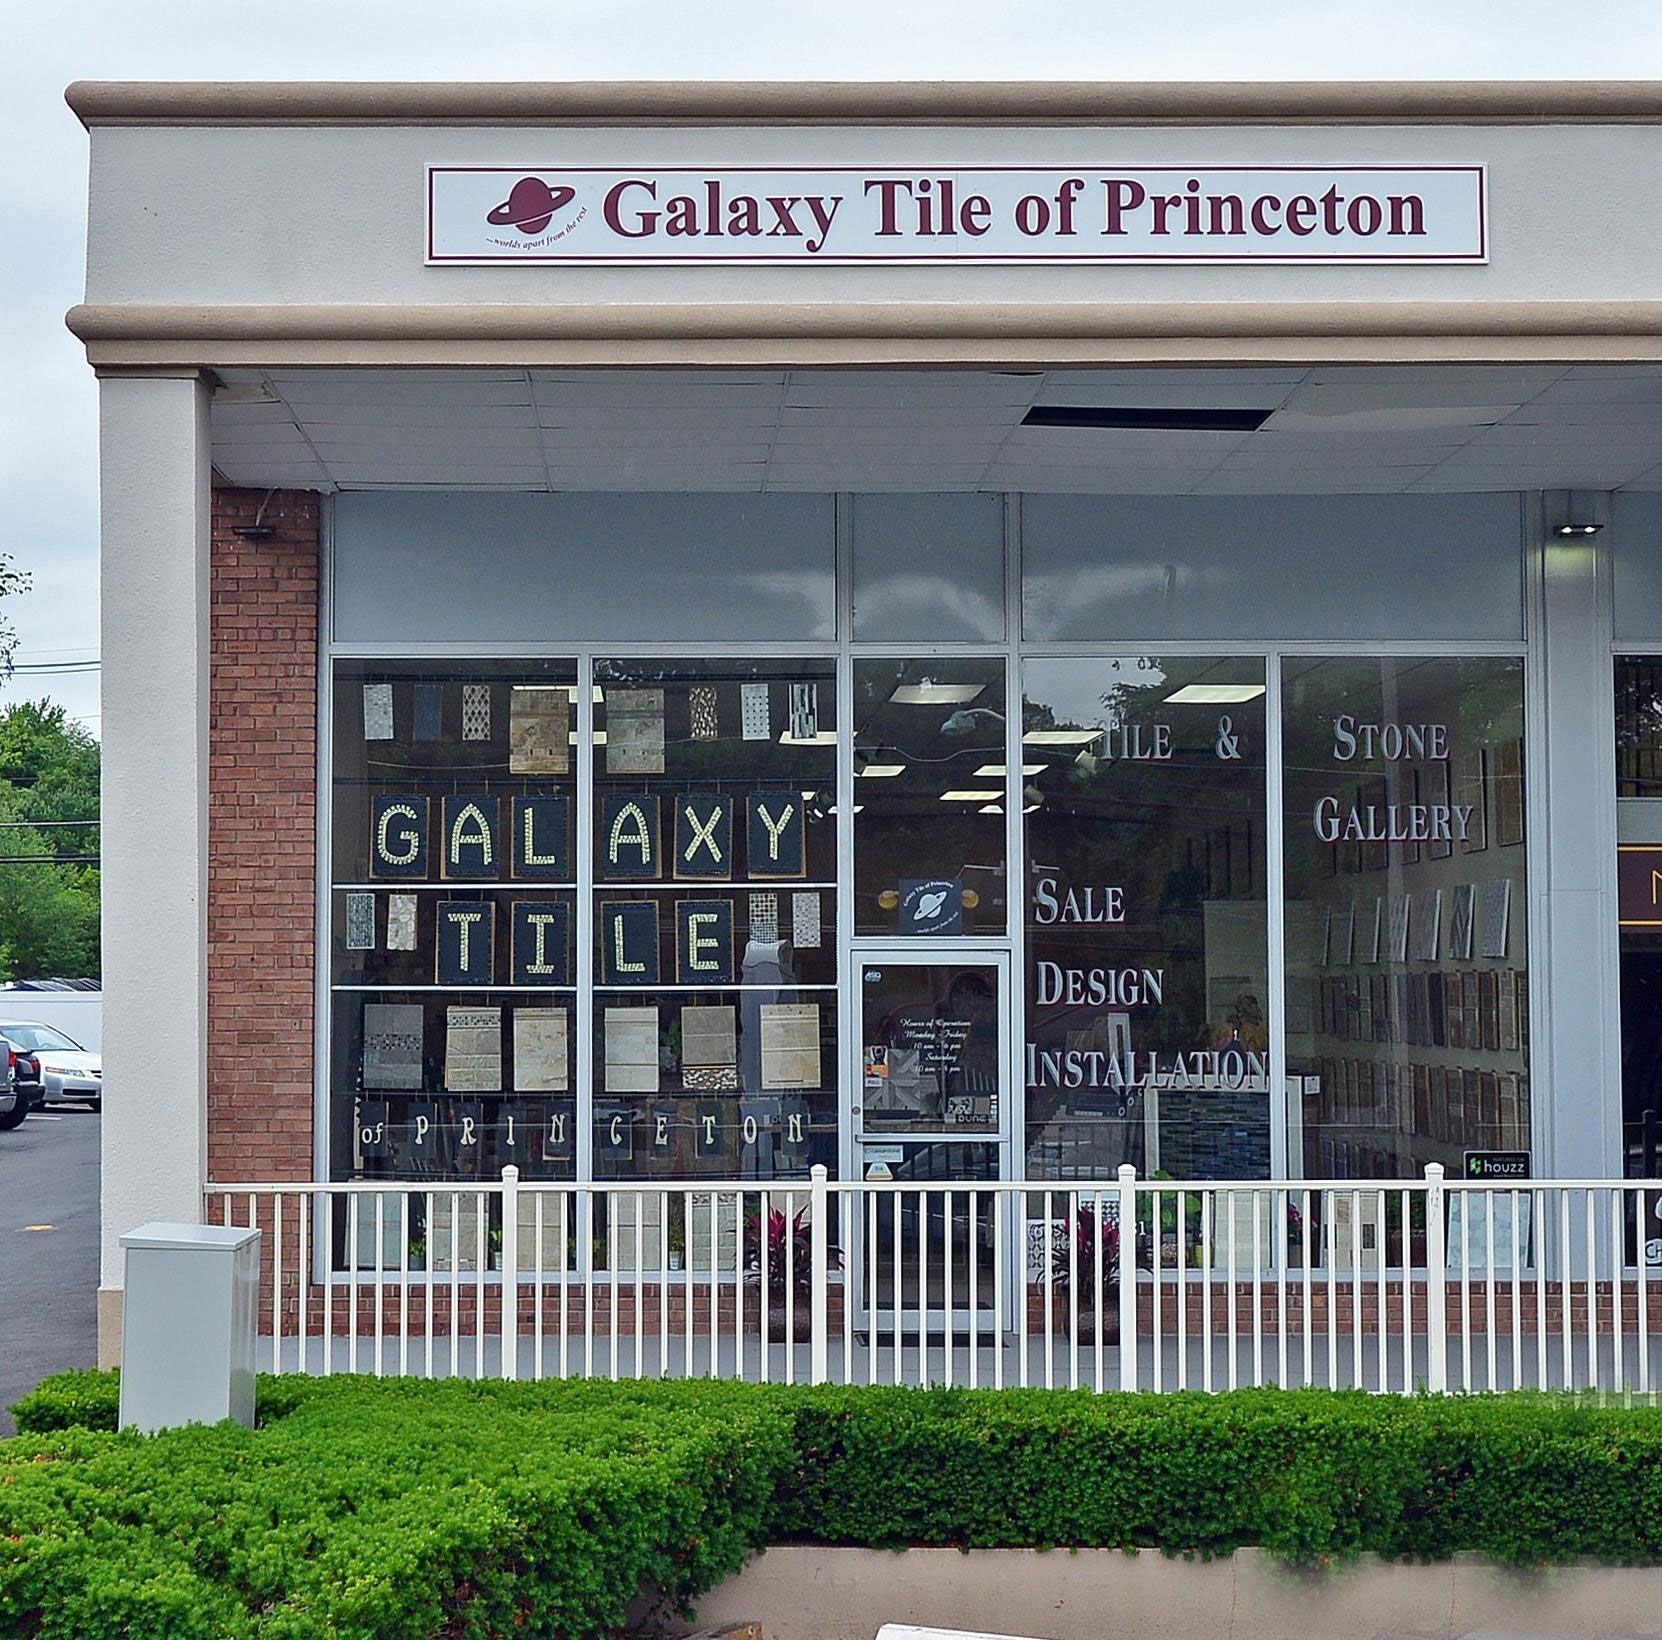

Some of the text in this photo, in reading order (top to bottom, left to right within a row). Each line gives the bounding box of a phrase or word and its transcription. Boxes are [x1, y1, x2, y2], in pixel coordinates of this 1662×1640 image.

[522, 239, 545, 250] apart
[546, 231, 565, 246] from
[565, 221, 577, 233] the
[576, 206, 588, 223] rest
[602, 178, 1428, 253] Galaxy Tile of Princeton
[1098, 714, 1449, 761] TILE & STONE
[377, 802, 793, 865] GALAXY
[1313, 796, 1473, 842] GALLERY
[1034, 878, 1126, 924] SALE
[448, 913, 719, 974] TILE
[1036, 961, 1164, 1006] DESIGN
[904, 1030, 936, 1040] Monday
[913, 1042, 923, 1050] 10
[925, 1018, 935, 1029] of
[925, 1052, 958, 1063] Saturday
[1026, 1043, 1269, 1090] INSTALLATION
[361, 1114, 804, 1146] of PRINCETON
[1484, 1159, 1525, 1173] houzz
